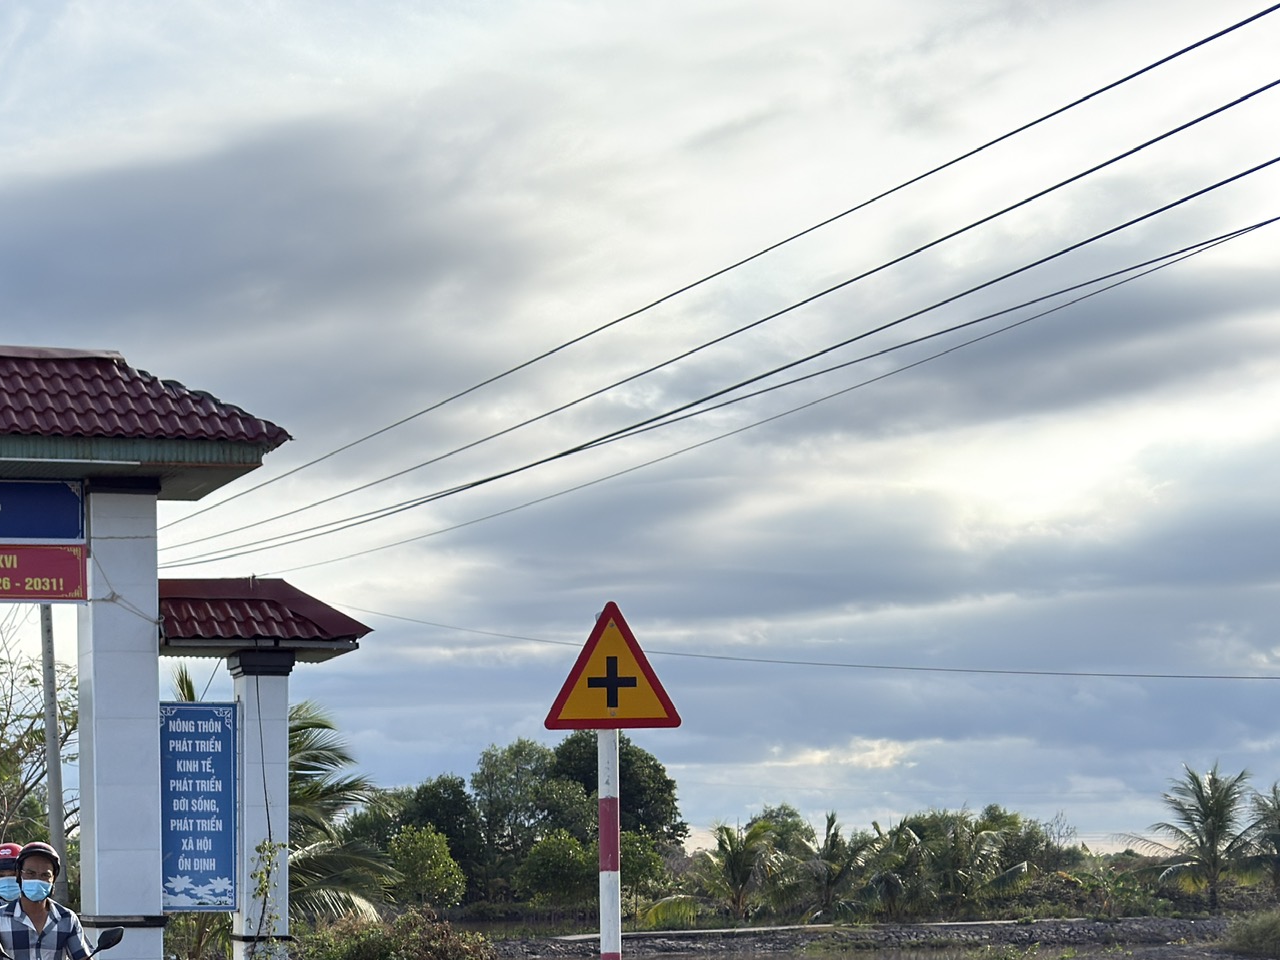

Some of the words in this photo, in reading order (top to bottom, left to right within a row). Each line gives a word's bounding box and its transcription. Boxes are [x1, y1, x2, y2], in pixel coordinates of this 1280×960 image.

[24, 578, 64, 591] 2031!
[169, 718, 195, 733] NÔNG
[197, 718, 221, 733] THÔN
[169, 737, 193, 752] PHÁT
[195, 735, 222, 752] TRIỂN
[176, 759, 199, 772] KINH
[201, 756, 215, 774] TẾ,
[170, 777, 194, 792] PHÁT
[195, 775, 222, 792] TRIỂN
[172, 796, 189, 811] ĐỜI
[191, 795, 220, 813] SỐNG,
[170, 816, 195, 832] PHÁT
[196, 814, 223, 832] TRIỂN
[181, 836, 195, 851] XÃ
[196, 836, 212, 853] HỘI
[178, 853, 192, 871] ỔN
[193, 858, 216, 874] ĐỊNH
